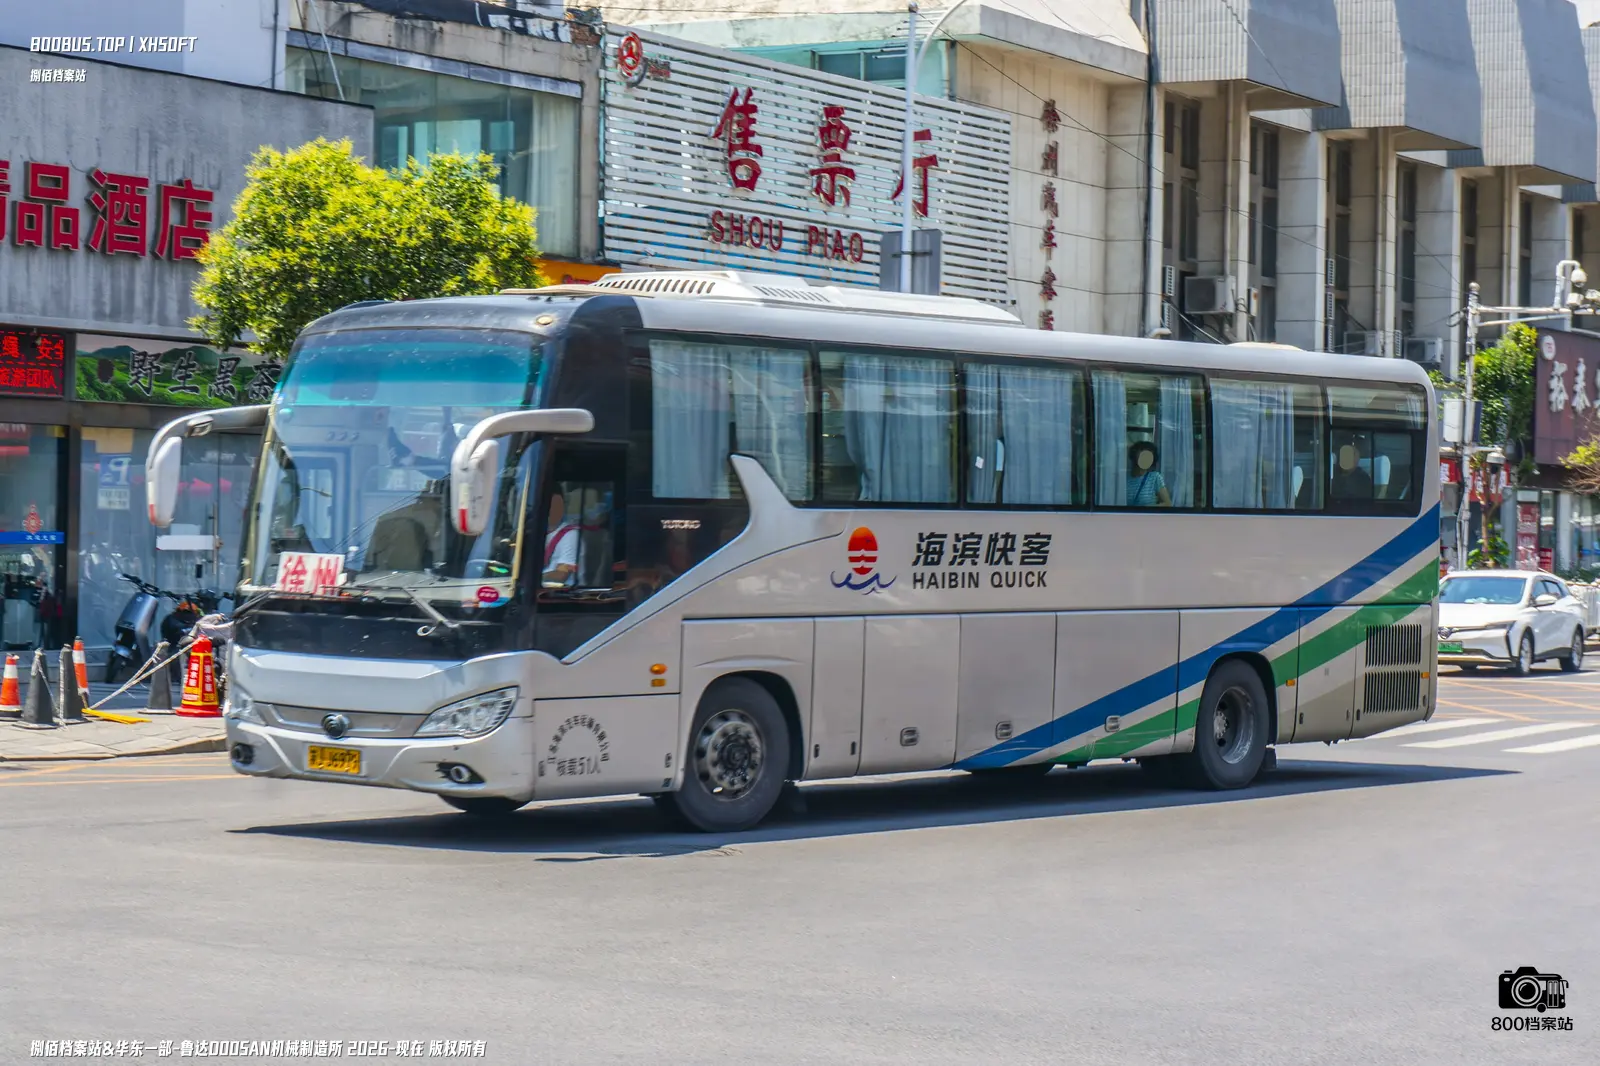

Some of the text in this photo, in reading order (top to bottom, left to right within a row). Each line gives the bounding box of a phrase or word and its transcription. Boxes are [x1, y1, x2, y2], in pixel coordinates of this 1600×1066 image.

[711, 87, 939, 217] 售票厅
[0, 160, 214, 260] 品酒店
[710, 210, 864, 263] SHOU PIAO
[128, 350, 282, 401] 野生黑茶
[911, 531, 1053, 567] 海滨快客
[281, 555, 340, 596] 徐州
[911, 570, 1048, 590] HAIBIN QUICK
